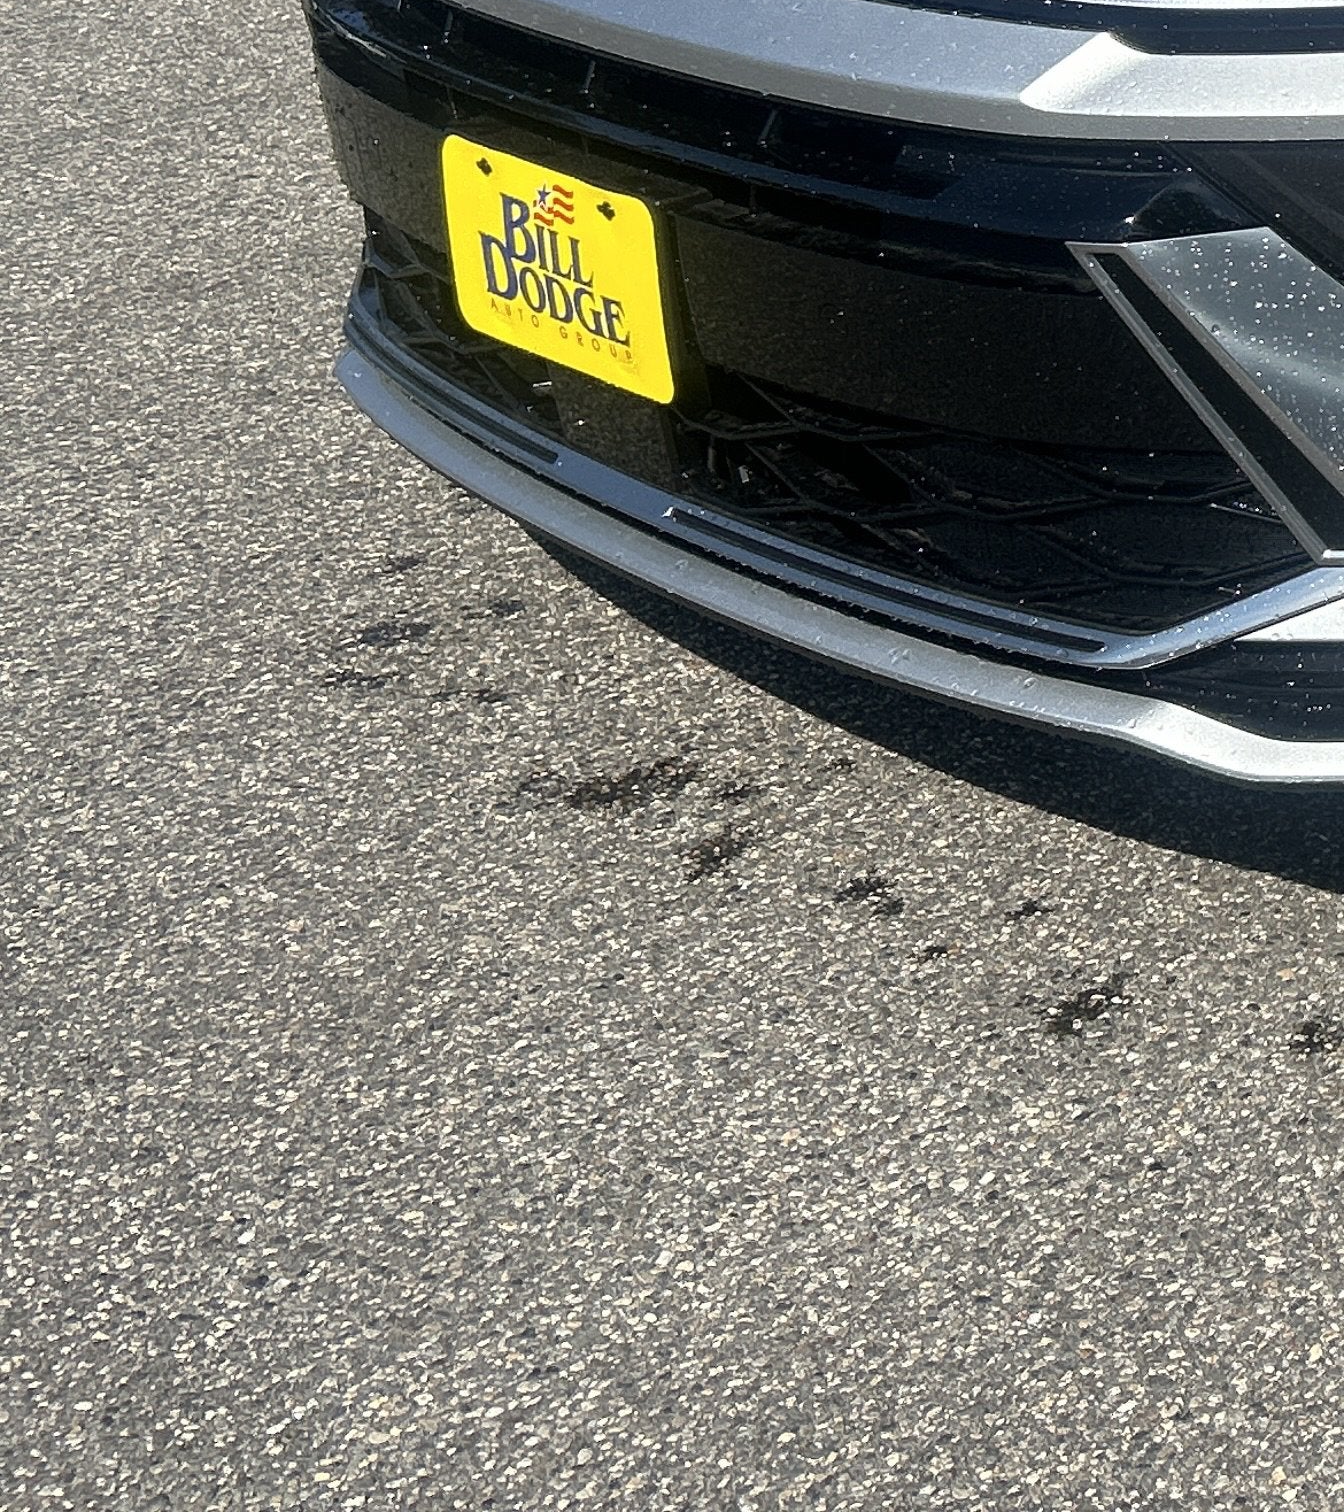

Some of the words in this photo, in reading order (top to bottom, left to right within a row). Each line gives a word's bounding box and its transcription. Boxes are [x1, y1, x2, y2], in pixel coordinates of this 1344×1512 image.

[500, 192, 594, 289] BILL
[478, 231, 631, 348] DODGE
[490, 297, 540, 329] AUTO
[559, 325, 632, 361] GROUP
